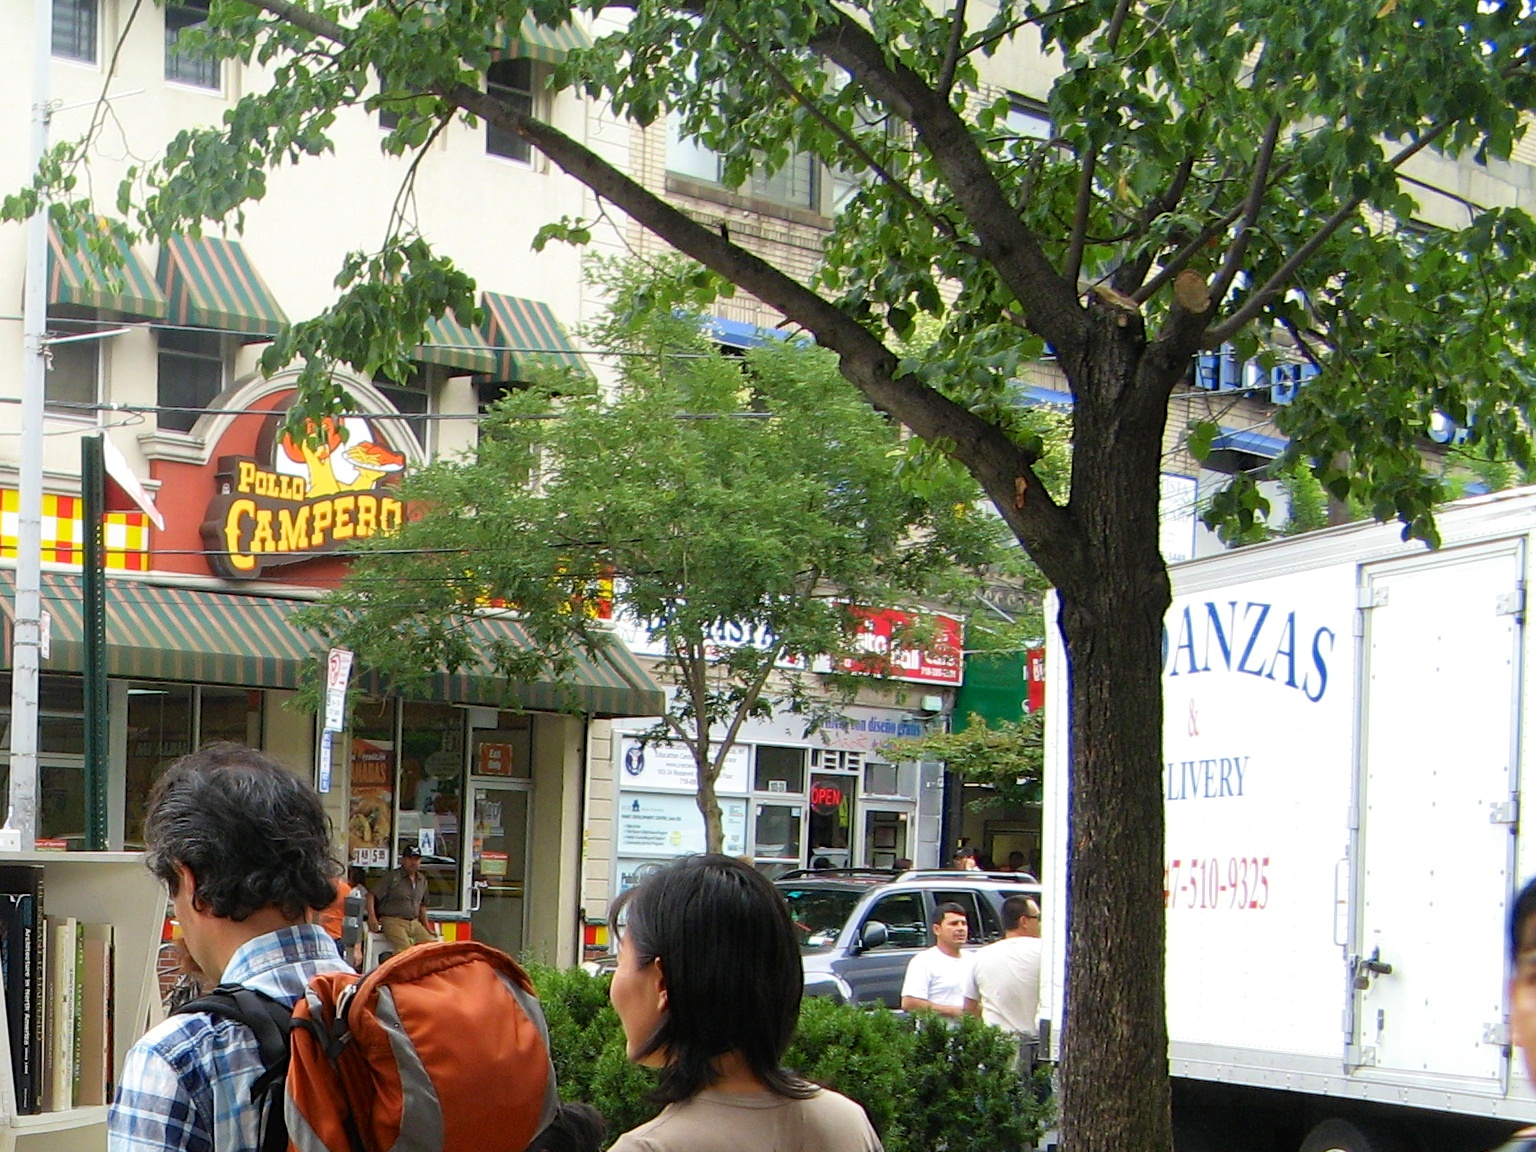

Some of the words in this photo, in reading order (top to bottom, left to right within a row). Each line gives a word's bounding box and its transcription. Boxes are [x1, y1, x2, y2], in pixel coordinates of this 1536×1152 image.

[238, 461, 305, 501] POLLO
[225, 497, 403, 571] CAMPERO
[1164, 600, 1336, 703] ANZAS
[1187, 698, 1200, 738] &
[811, 787, 842, 805] OPEN
[1165, 755, 1252, 801] LIVERY
[421, 832, 432, 850] A
[24, 979, 30, 987] in
